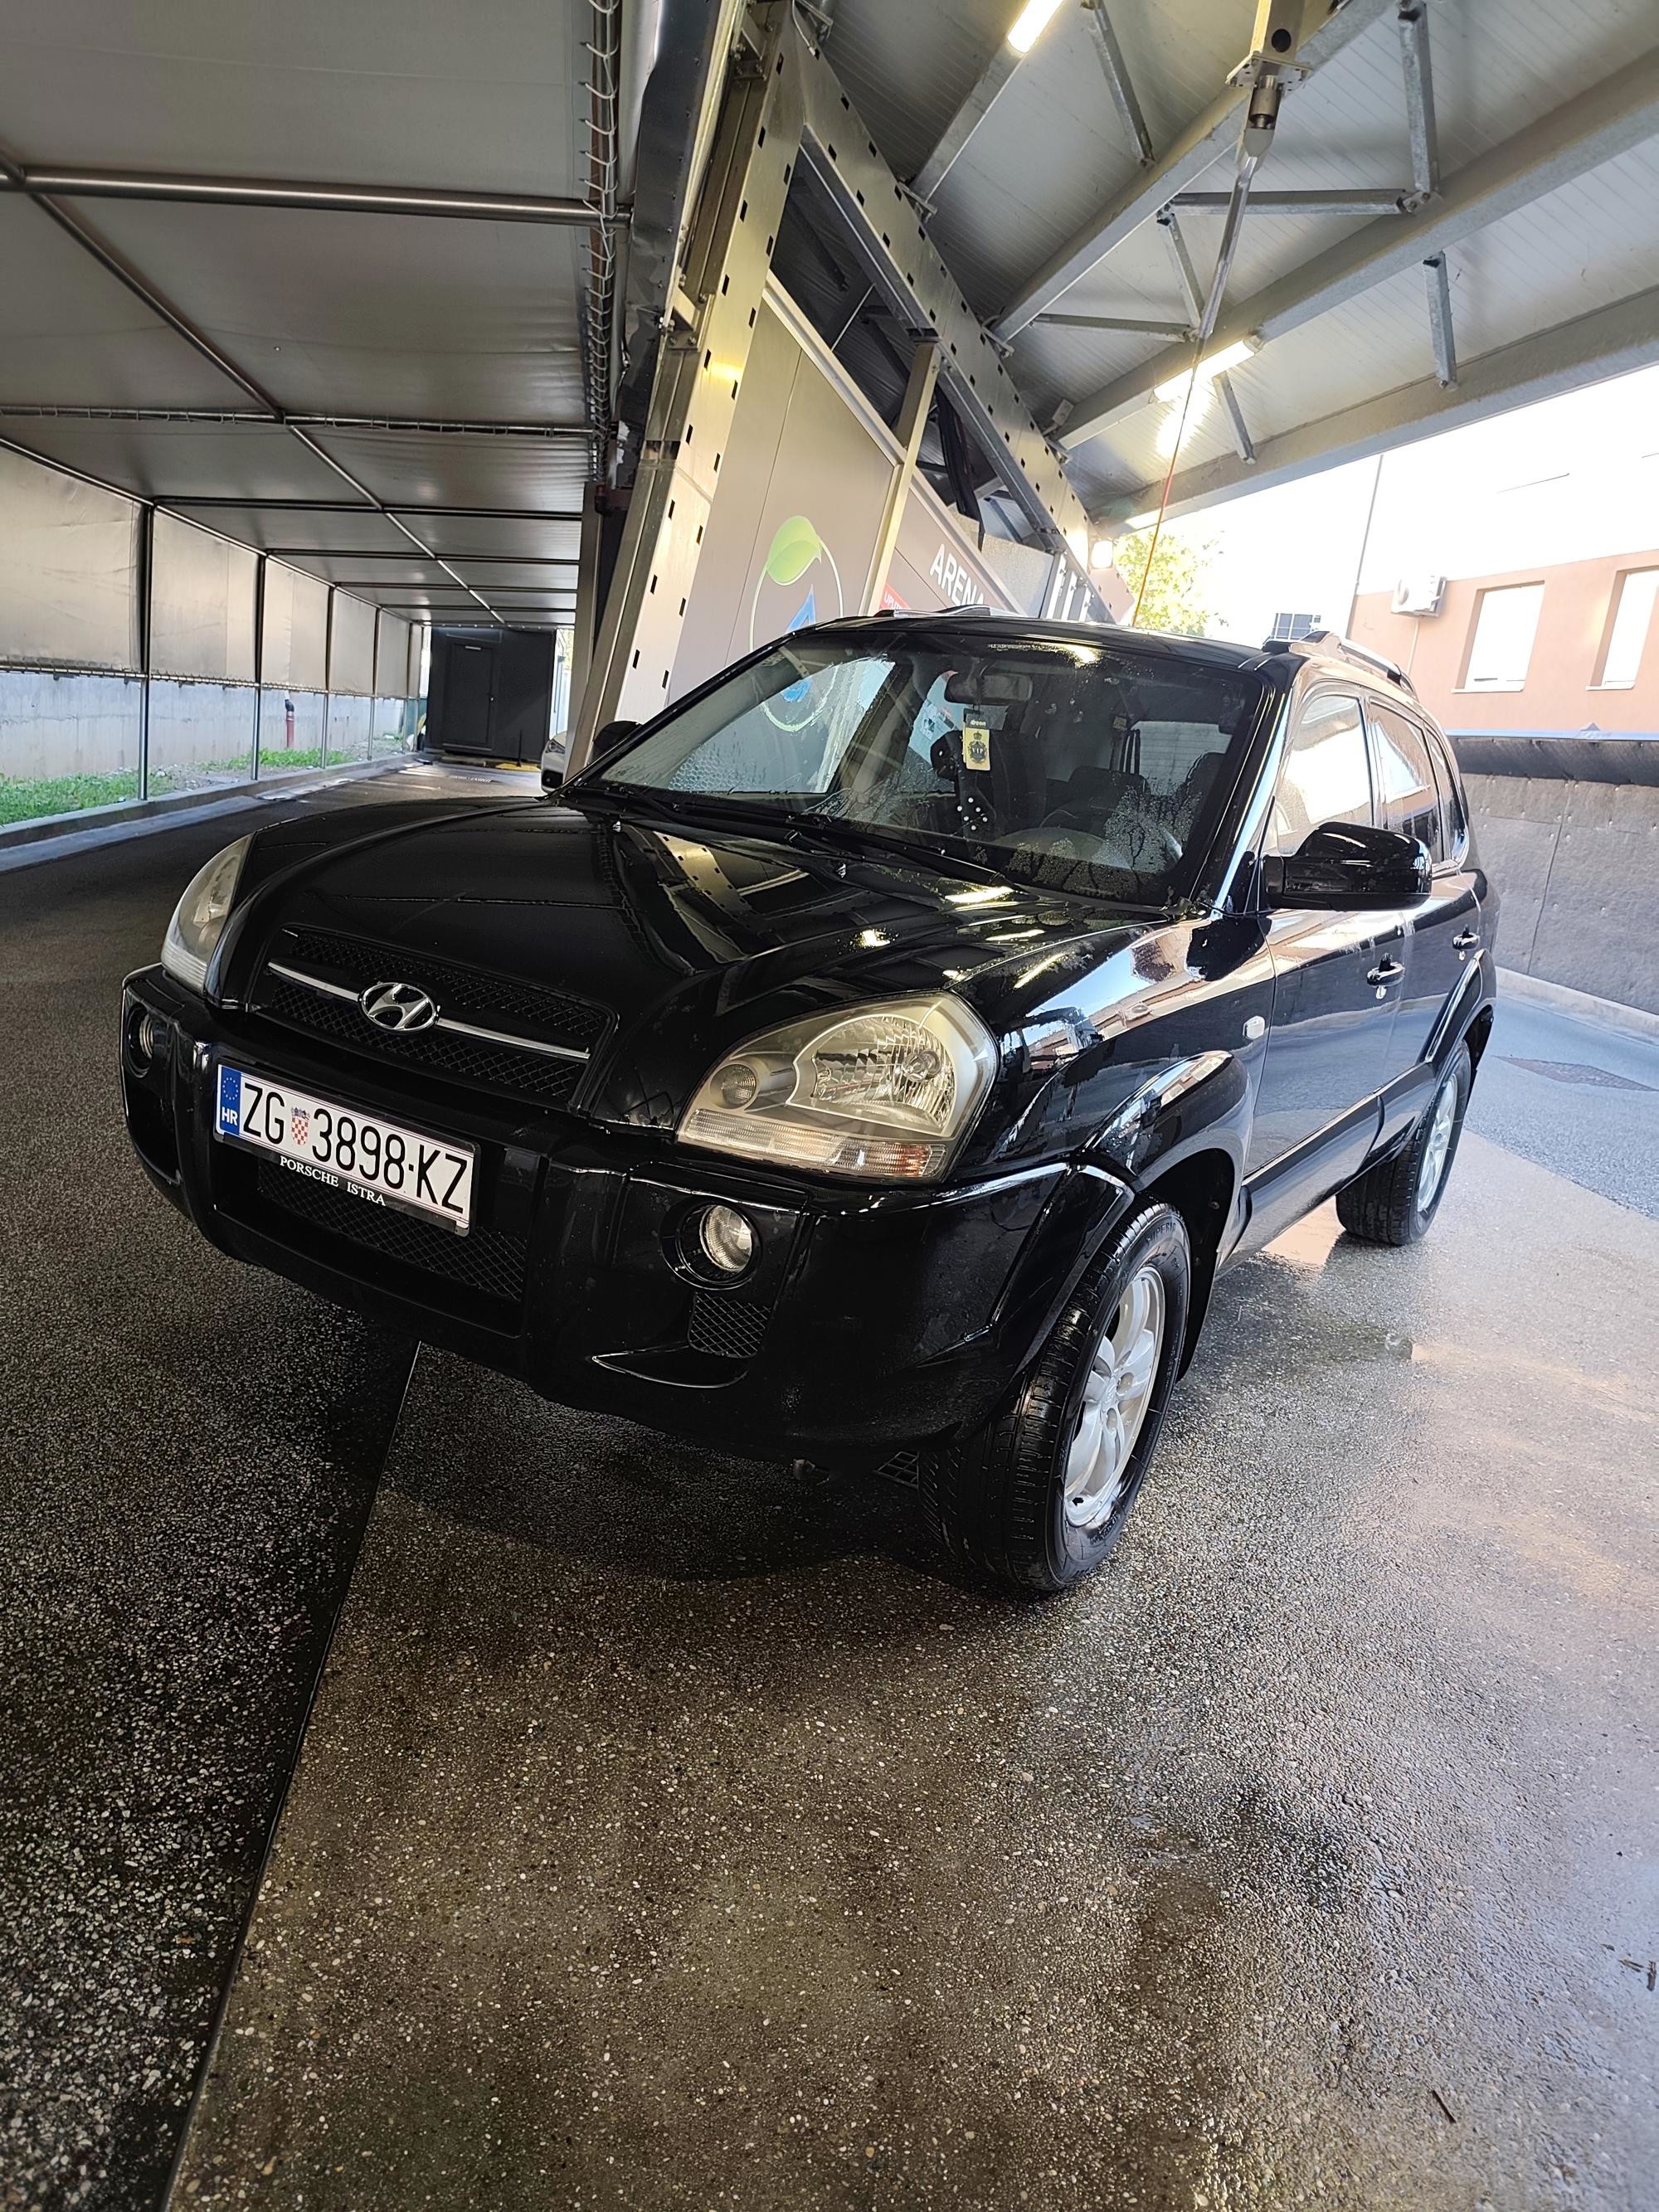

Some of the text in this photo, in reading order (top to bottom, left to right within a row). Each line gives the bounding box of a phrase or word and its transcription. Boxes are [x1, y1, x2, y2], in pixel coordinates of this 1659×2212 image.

[221, 1106, 238, 1125] HR
[243, 1082, 285, 1145] ZG
[280, 1155, 386, 1207] PORSCHE ISTRA
